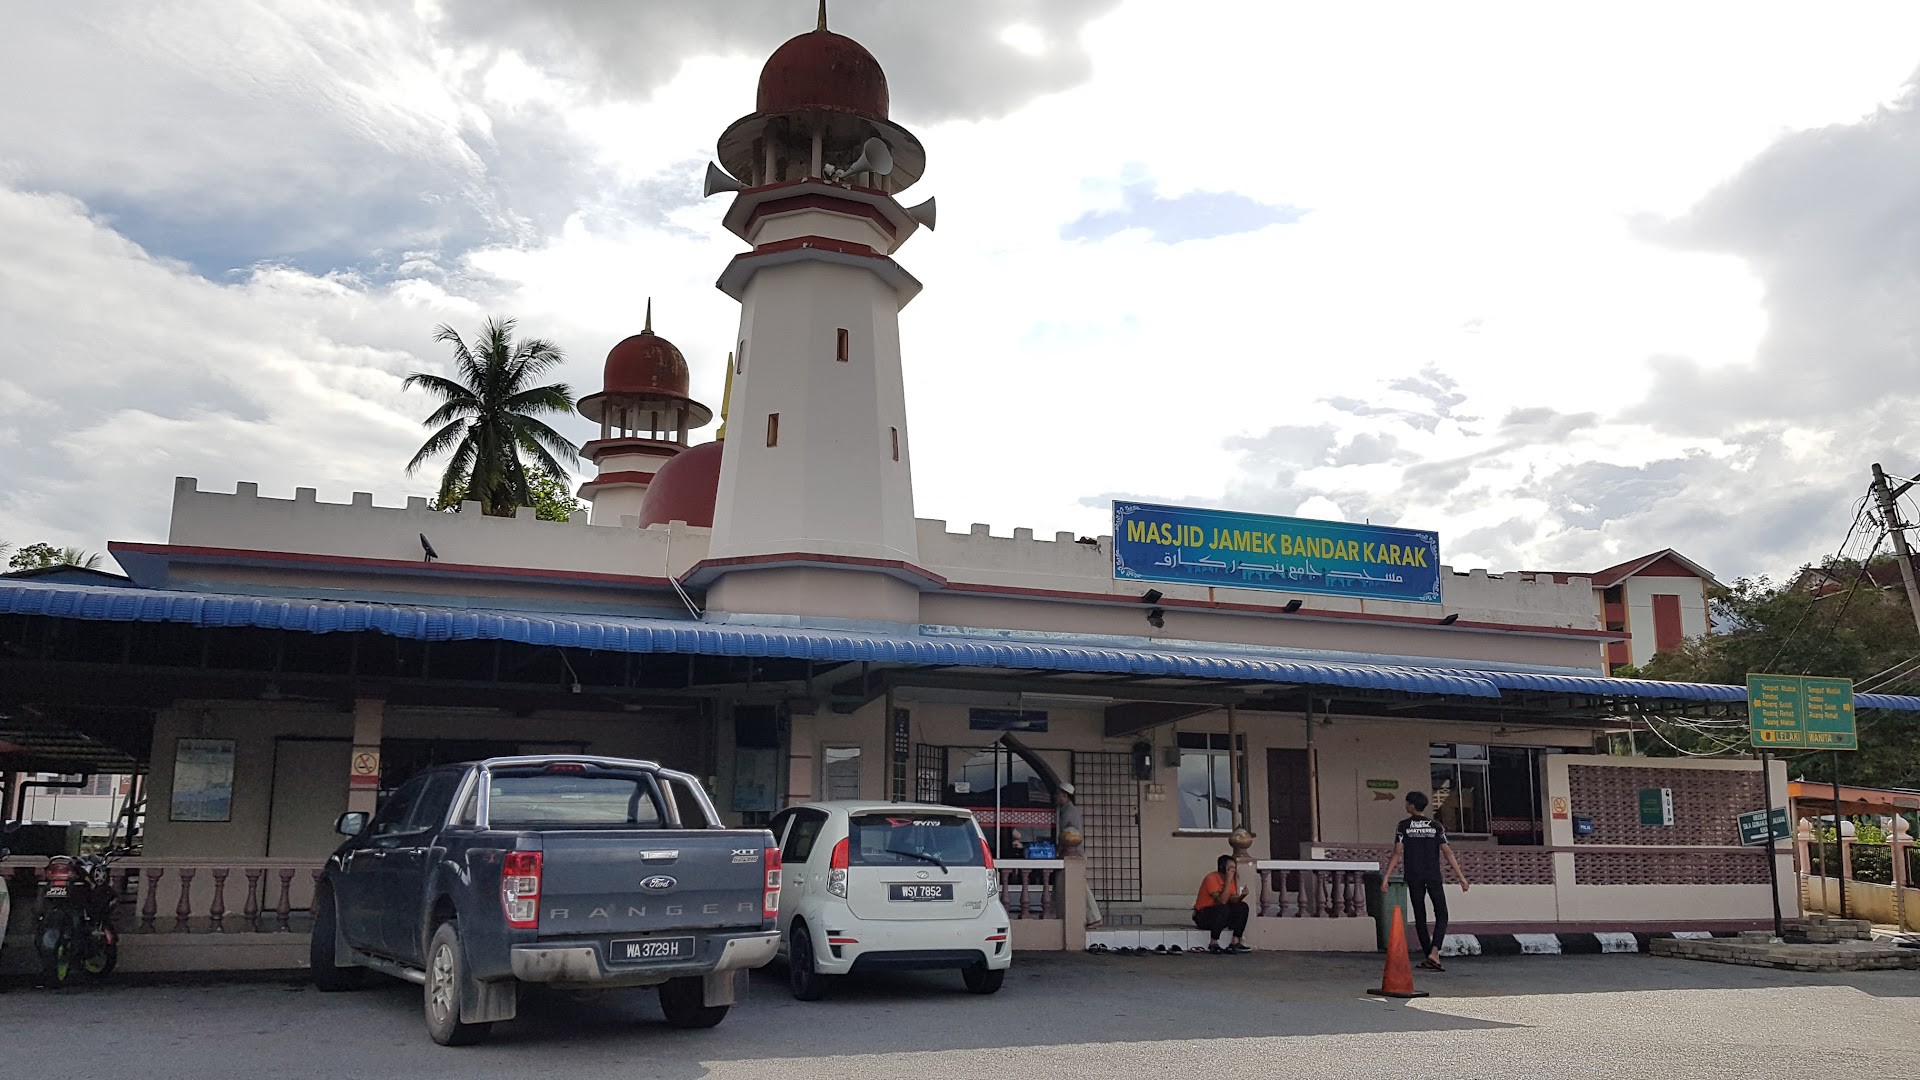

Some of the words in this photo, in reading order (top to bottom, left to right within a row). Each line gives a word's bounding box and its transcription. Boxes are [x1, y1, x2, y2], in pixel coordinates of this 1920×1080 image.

[1127, 520, 1204, 547] MASJID
[1209, 528, 1277, 554] JAMEK
[1281, 534, 1360, 561] BANDAR
[1364, 542, 1428, 568] KARAK
[1777, 733, 1800, 742] LELAKI
[731, 848, 758, 856] XLT
[650, 877, 670, 888] Ford
[901, 886, 918, 897] WSY
[919, 886, 942, 897] 7852
[550, 902, 754, 919] RANGER
[626, 943, 641, 958] WA
[642, 942, 670, 957] 3729
[670, 941, 679, 955] H
